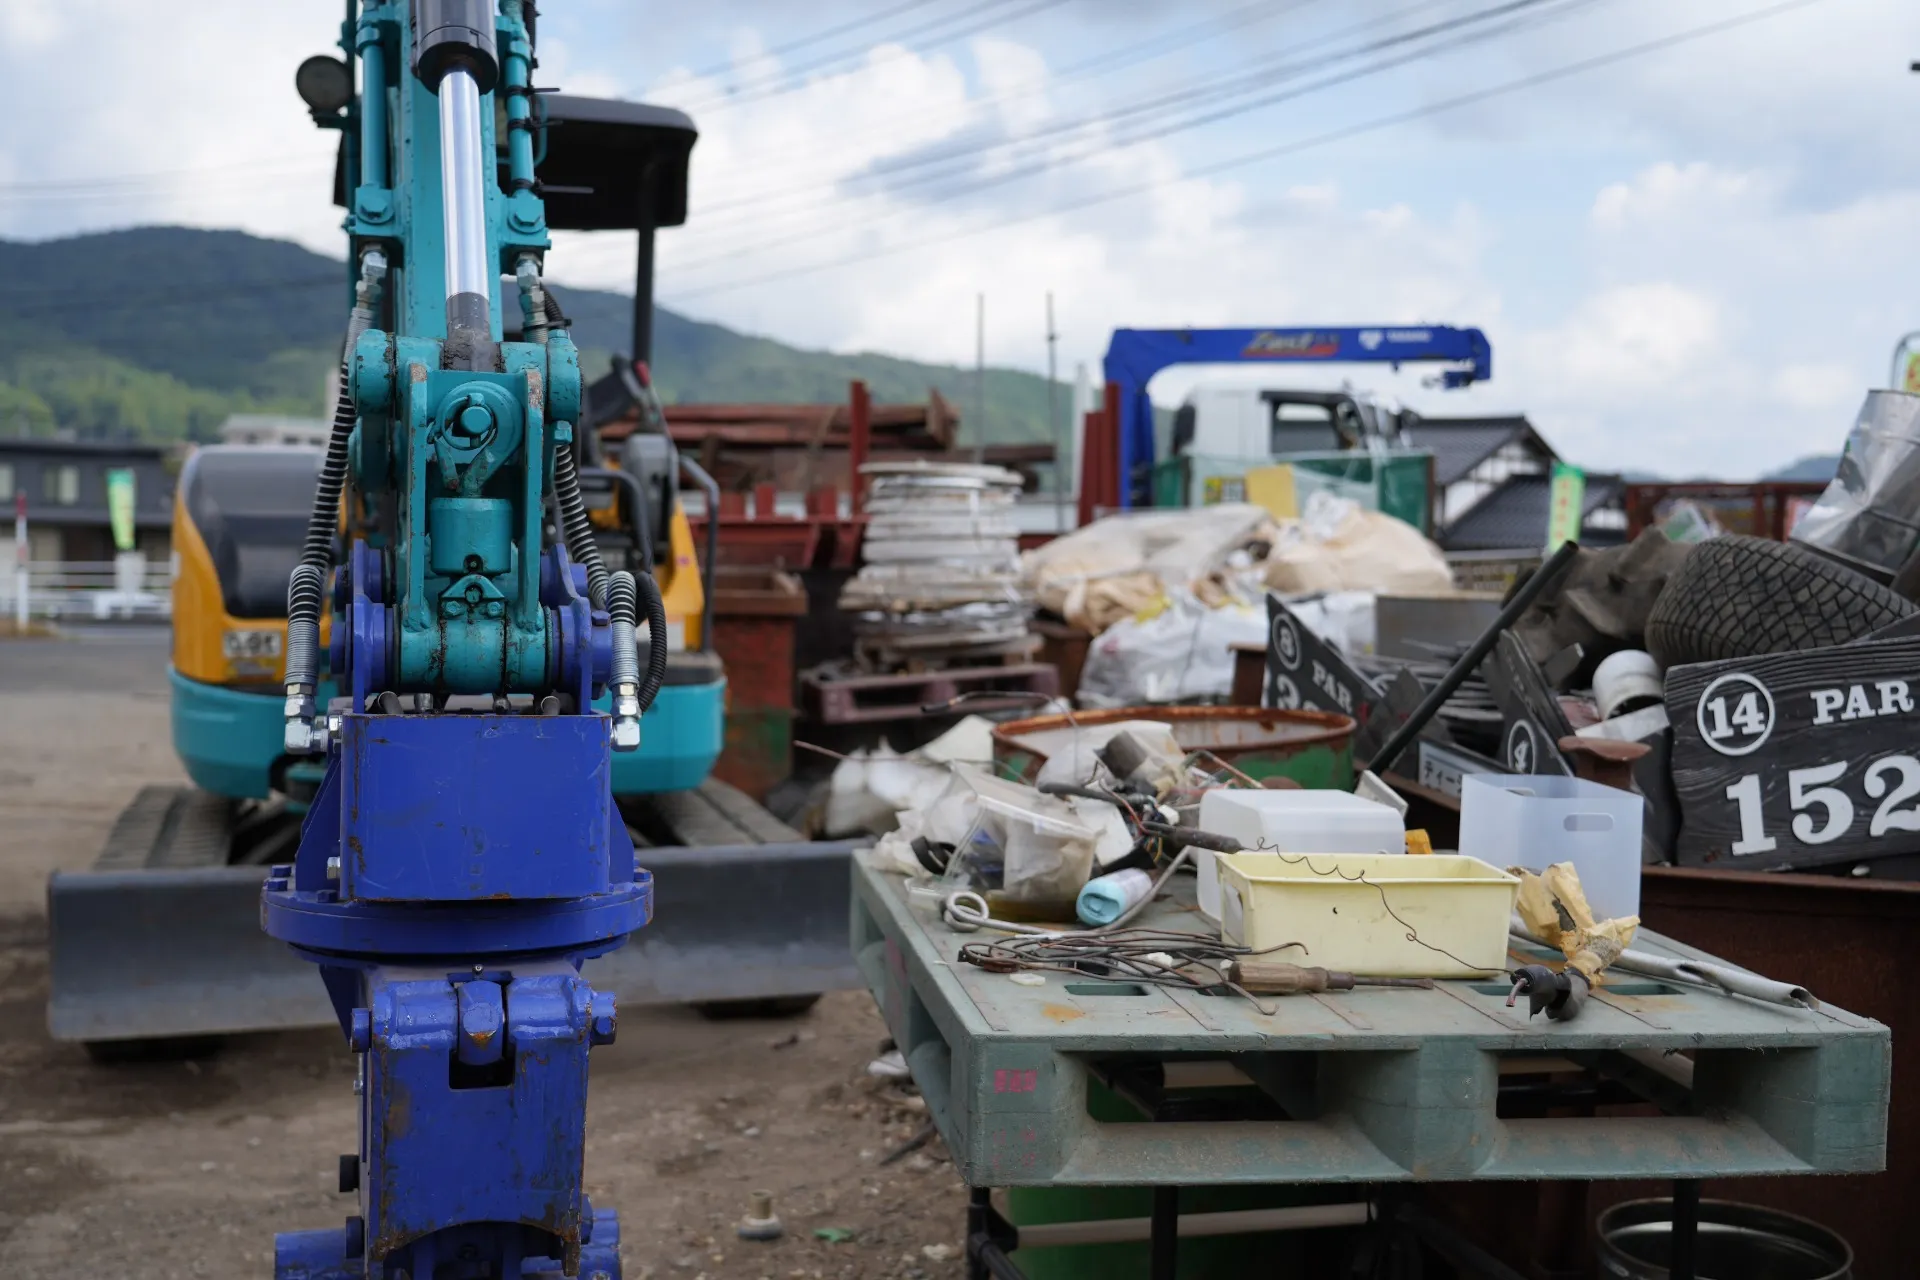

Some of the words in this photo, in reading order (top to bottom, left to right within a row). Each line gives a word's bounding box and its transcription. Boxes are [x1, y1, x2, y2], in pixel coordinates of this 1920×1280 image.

[1311, 658, 1353, 715] PAR
[1706, 691, 1766, 740] 14
[1809, 680, 1915, 726] PAR
[1725, 754, 1920, 857] 152
